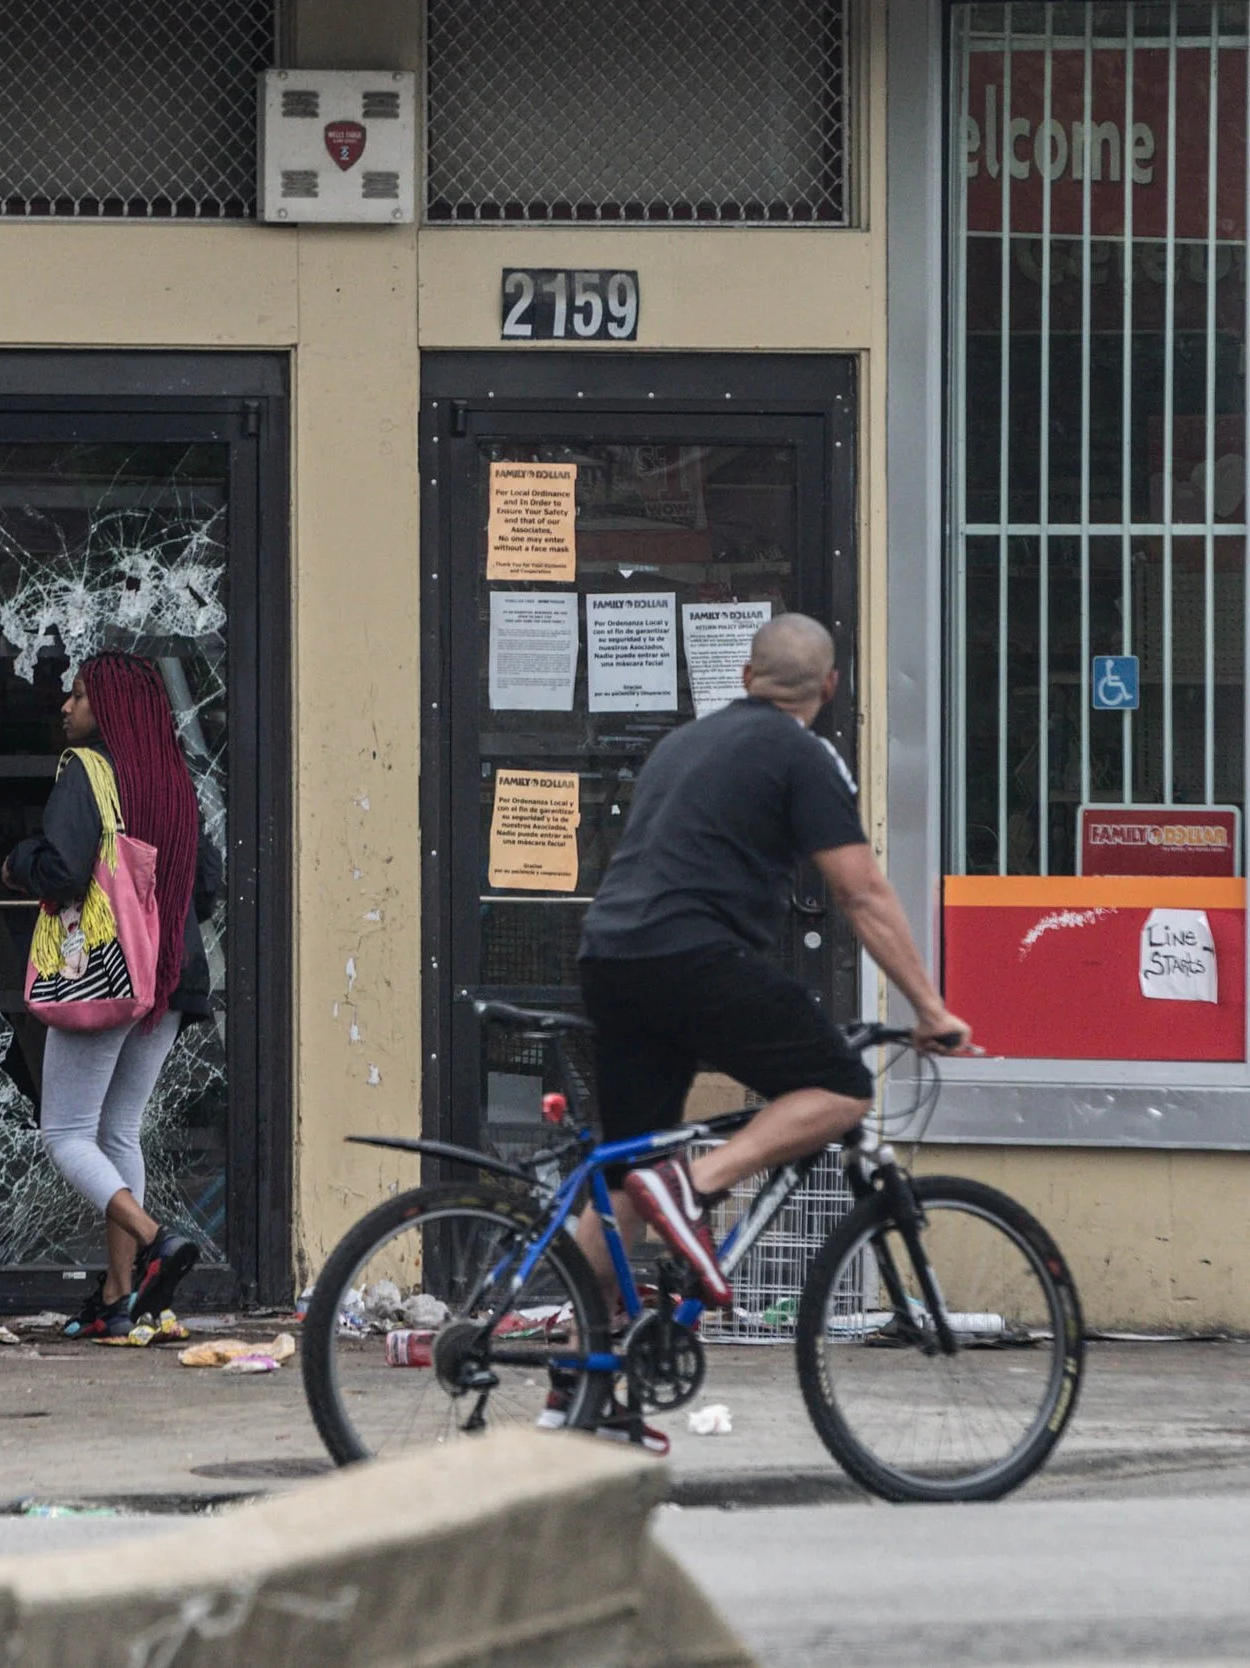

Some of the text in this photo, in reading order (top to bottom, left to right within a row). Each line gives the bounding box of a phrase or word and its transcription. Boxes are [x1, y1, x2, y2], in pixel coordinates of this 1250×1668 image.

[503, 272, 637, 337] 2159
[495, 470, 570, 479] FAMILY DOLLAR
[544, 508, 568, 516] Safety
[593, 600, 668, 609] FAMILY DOLLAR
[690, 611, 763, 620] FAMILY DOLLAR
[499, 777, 575, 789] FAMILY DOLLAR
[1090, 824, 1228, 846] FAMILY DOLLAR
